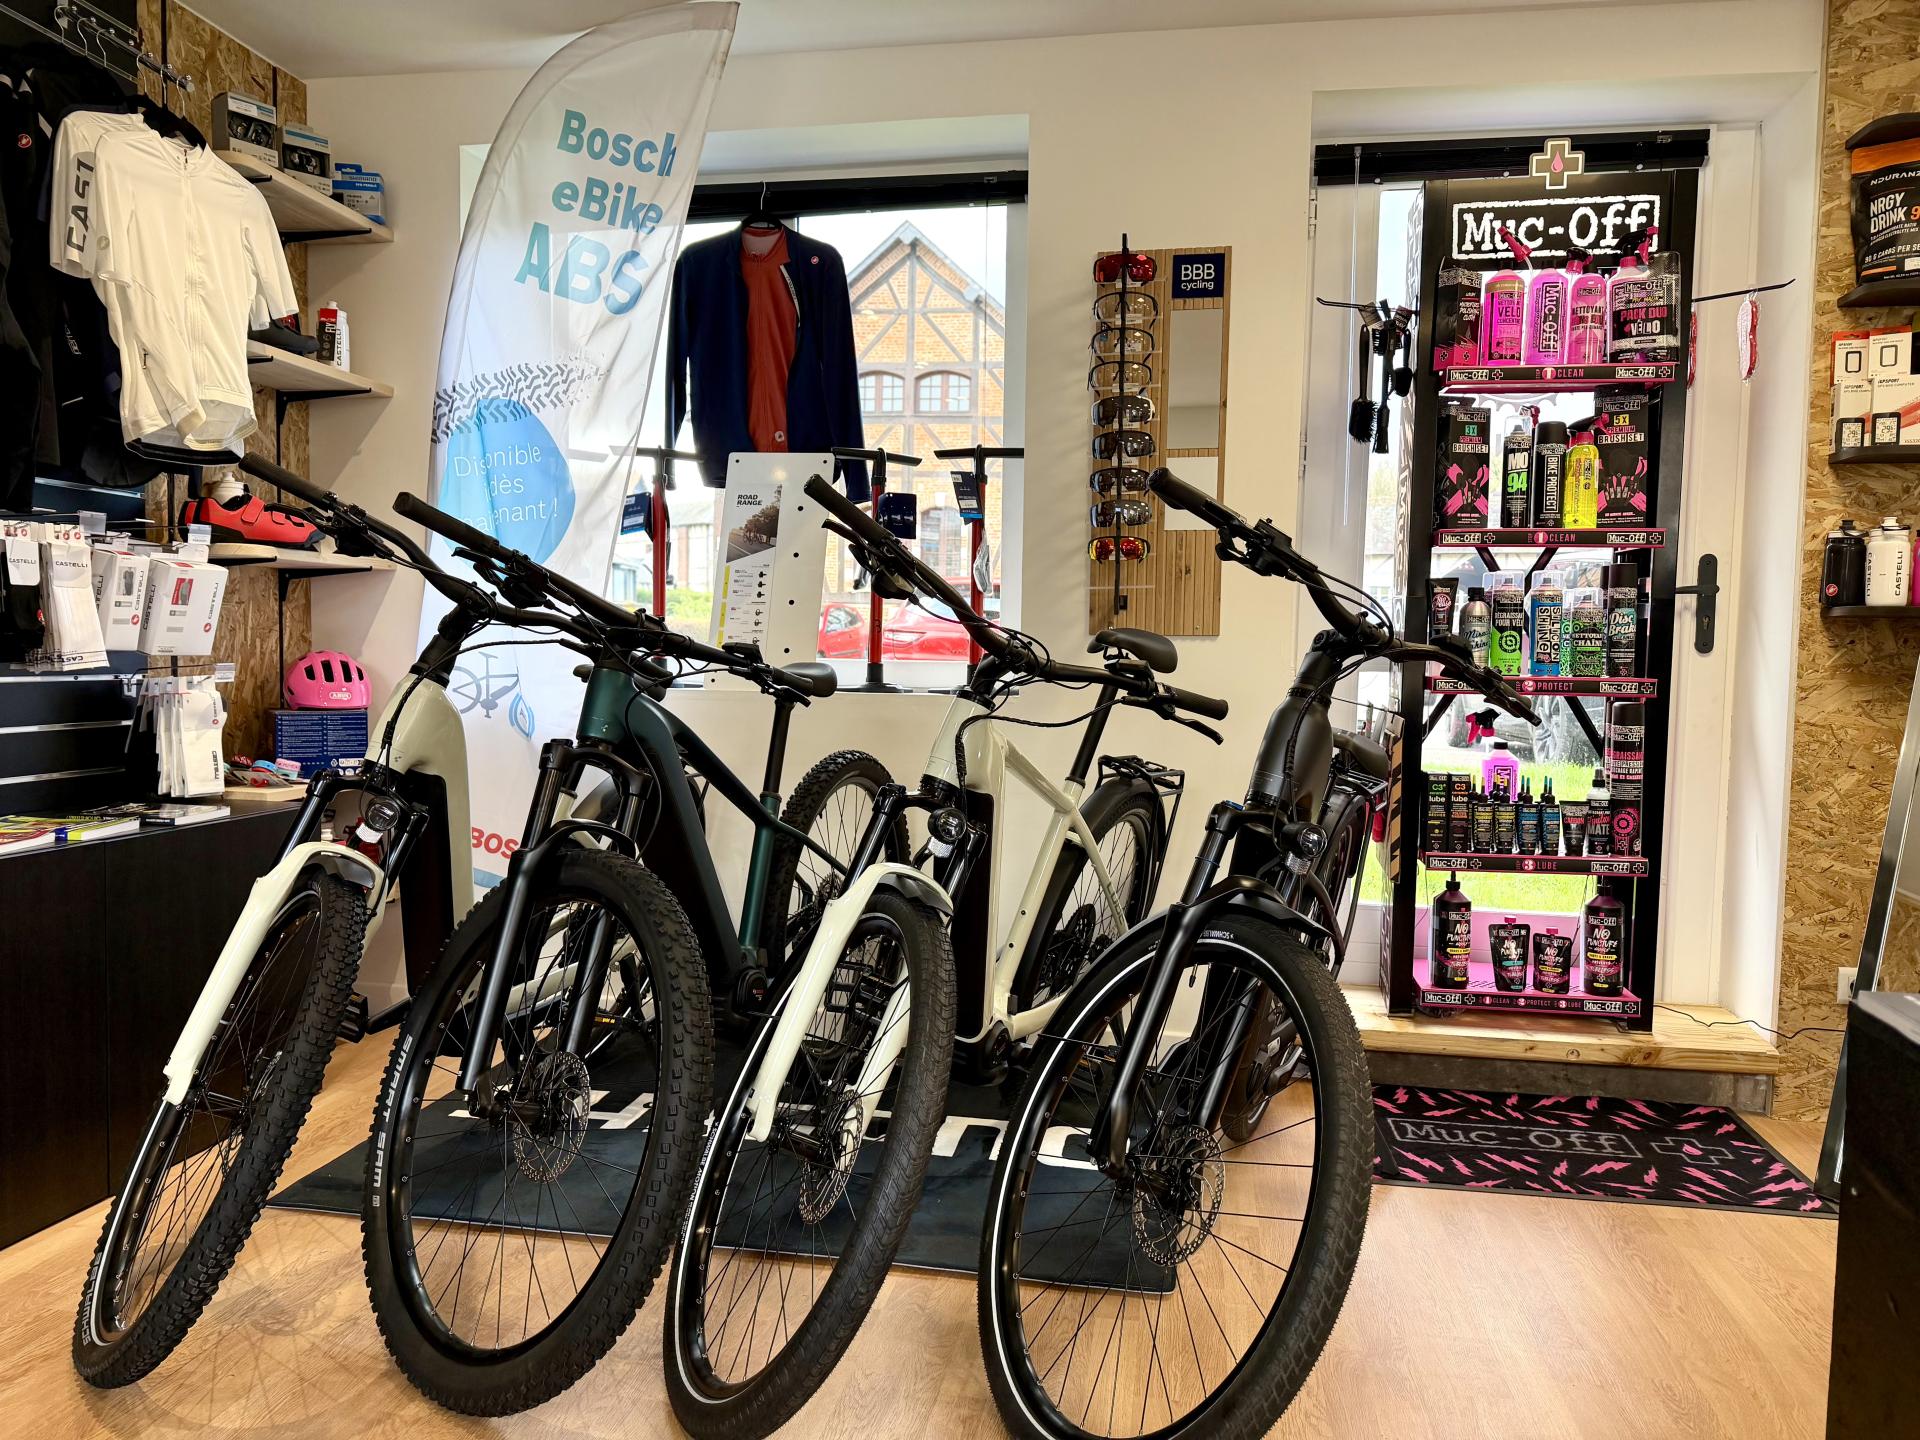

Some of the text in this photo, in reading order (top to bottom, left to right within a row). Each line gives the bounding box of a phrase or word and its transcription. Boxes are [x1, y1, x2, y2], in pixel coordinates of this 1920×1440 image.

[557, 109, 677, 177] Bosch
[552, 177, 663, 235] eBike
[1870, 192, 1905, 217] NRGY
[1870, 206, 1908, 233] DRINK
[1462, 200, 1650, 252] Muc-Off
[1878, 246, 1896, 258] CARBS
[1897, 244, 1911, 253] PER
[514, 221, 650, 315] ABS
[1181, 263, 1215, 281] BBB
[1181, 280, 1214, 291] cycling
[1626, 279, 1661, 293] Muc-Off
[1542, 284, 1561, 350] Muc-Off
[1621, 306, 1668, 321] PACK DUO
[1452, 371, 1488, 380] Muc-Off
[1557, 368, 1584, 378] CLEAN
[1617, 366, 1654, 377] Muc-Off
[1604, 401, 1640, 411] Muc-Off
[1457, 412, 1485, 421] Muc-Off
[1598, 433, 1645, 444] BRUSH SET
[1453, 443, 1488, 453] BRUSH SET
[1507, 452, 1529, 470] MO
[1507, 472, 1528, 493] 94
[1546, 456, 1559, 511] BIKE PROTECT
[1444, 533, 1480, 543] Muc-Off
[1549, 533, 1576, 542] CLEAN
[1608, 533, 1645, 543] Muc-Off
[8, 557, 37, 565] CASTELLI
[55, 560, 88, 568] CASTELLI
[1894, 551, 1903, 596] CASTELLI
[208, 582, 219, 620] CASTELLI
[143, 584, 157, 630] CASTELLI
[1610, 612, 1634, 624] Disc
[1525, 680, 1533, 691] 2
[1537, 682, 1573, 691] PROTECT
[1601, 682, 1637, 693] Muc-Off
[212, 750, 220, 780] CASTELLI
[1451, 795, 1468, 803] lube
[471, 826, 519, 859] BOS
[1431, 859, 1467, 868] Muc-Off
[1524, 860, 1557, 870] 3 LUBE
[1593, 862, 1628, 872] Muc-Off
[1589, 916, 1616, 926] Muc-Off
[1455, 924, 1469, 934] NO
[1593, 928, 1611, 940] NO
[1587, 937, 1618, 948] PUNCTURE
[1544, 946, 1559, 956] NO
[1426, 994, 1460, 1003] Muc-Off
[1527, 999, 1551, 1007] PROTECT
[1560, 1000, 1566, 1008] 3
[1585, 1001, 1620, 1011] Muc-Off
[373, 1033, 413, 1187] SMART SAM
[1403, 1121, 1633, 1155] Muc-Off
[700, 1127, 718, 1166] SCHWALBE
[81, 1252, 103, 1347] SCHWALBE
